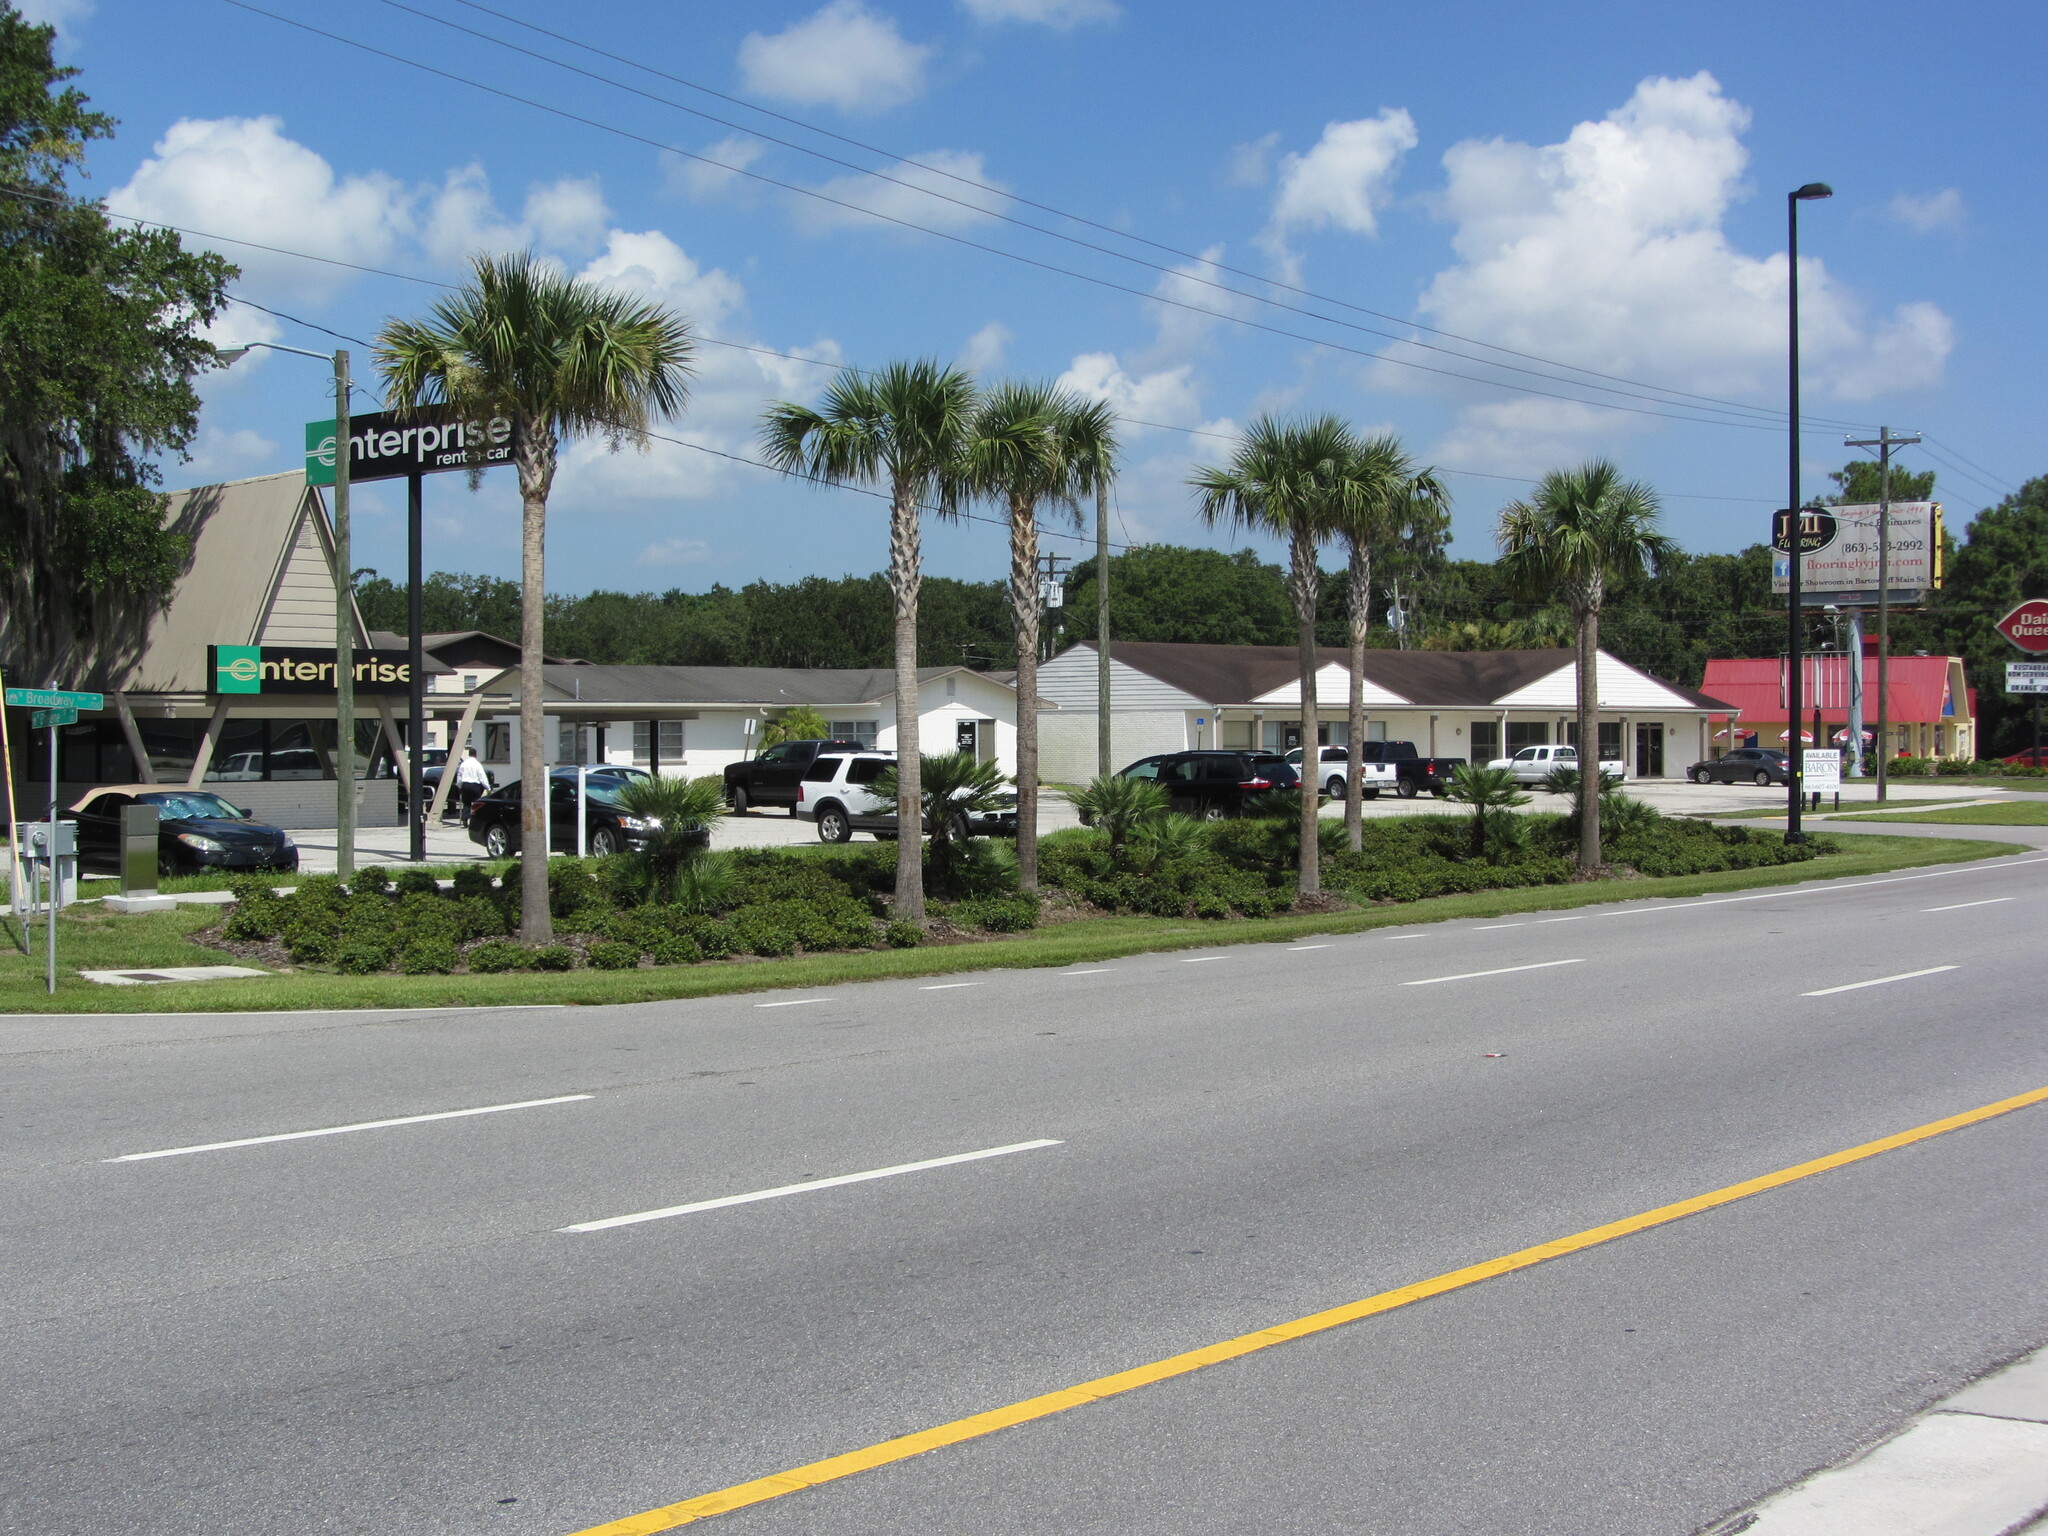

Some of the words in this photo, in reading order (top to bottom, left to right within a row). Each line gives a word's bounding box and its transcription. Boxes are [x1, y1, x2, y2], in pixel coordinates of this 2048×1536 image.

[1876, 518, 1922, 527] Etimates
[1778, 537, 1822, 549] FLRING
[1841, 540, 1923, 556] (863)-53-2992
[1806, 557, 1924, 572] flooringbyji.com
[1805, 578, 1845, 587] Showroom
[1846, 577, 1853, 585] in
[1895, 575, 1915, 583] Main
[2021, 613, 2048, 625] Dai
[27, 692, 75, 707] Broadway
[1805, 763, 1838, 774] BARON
